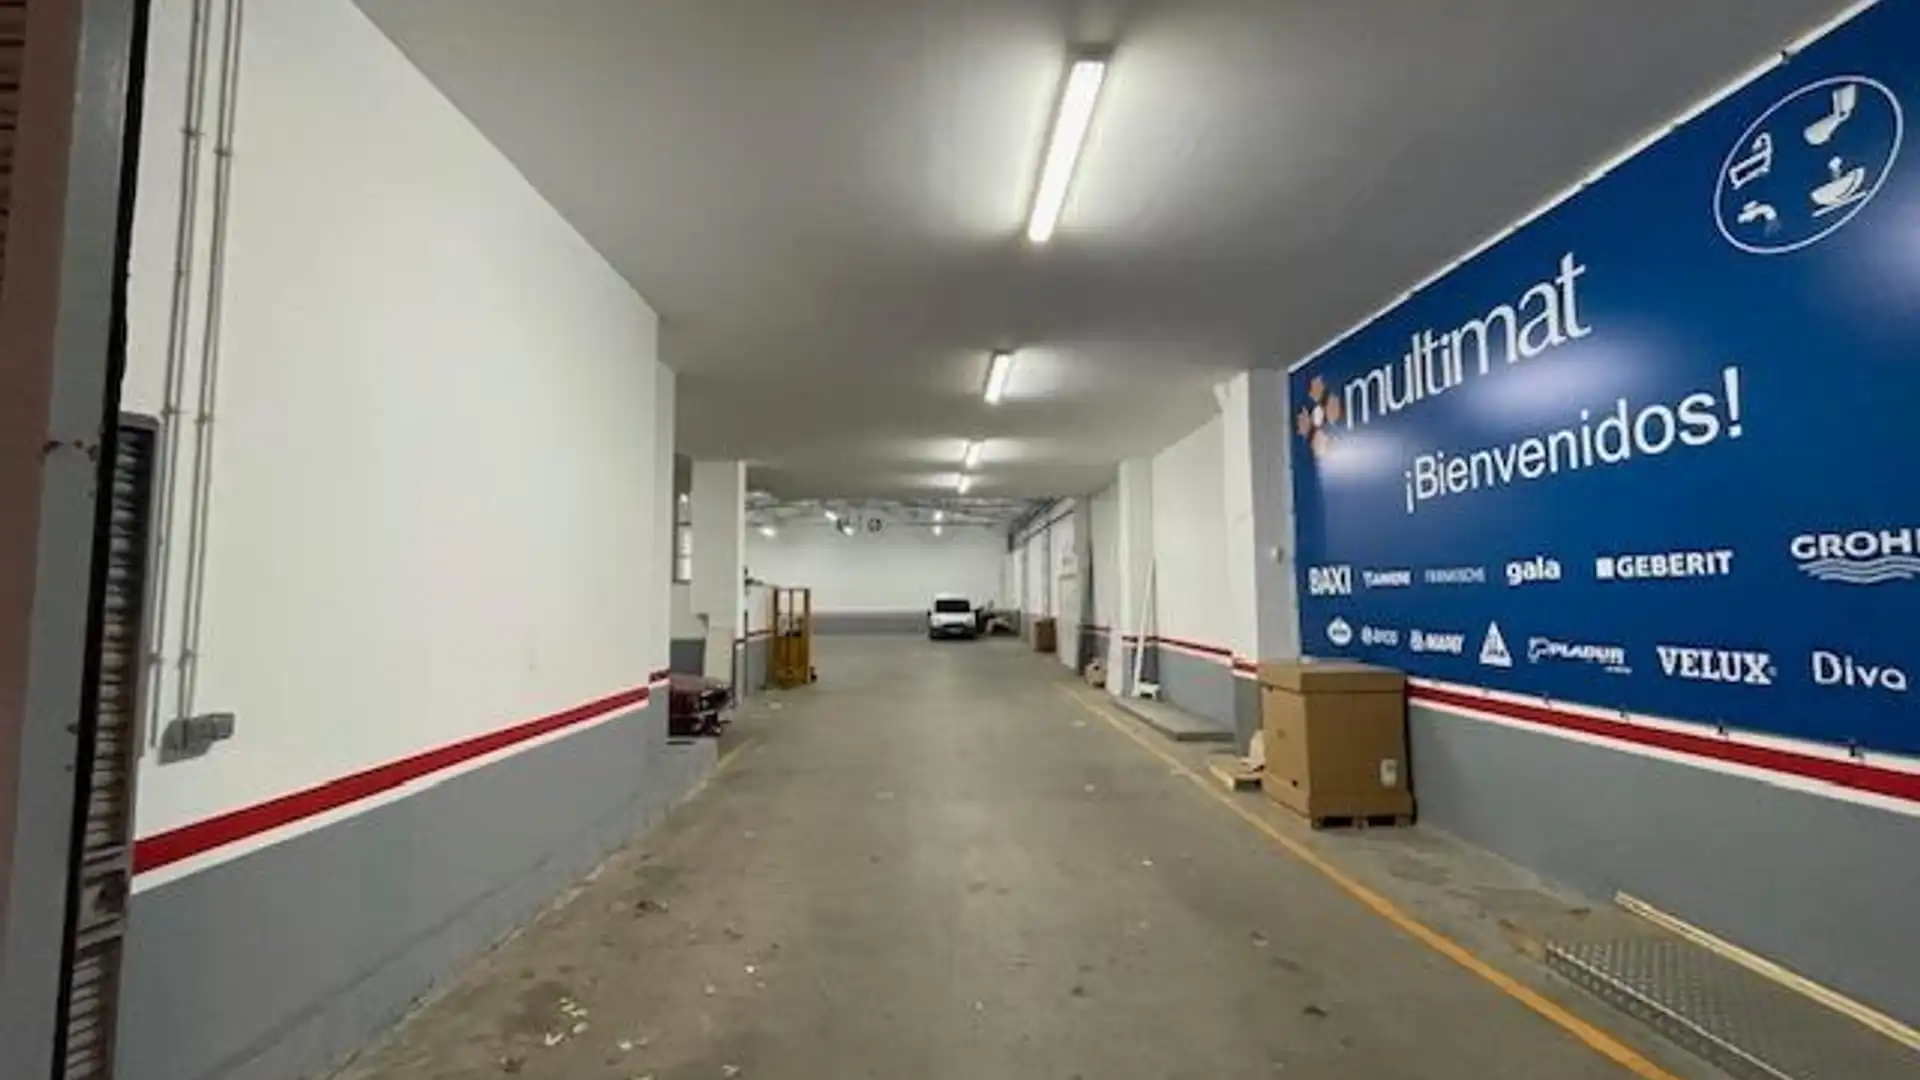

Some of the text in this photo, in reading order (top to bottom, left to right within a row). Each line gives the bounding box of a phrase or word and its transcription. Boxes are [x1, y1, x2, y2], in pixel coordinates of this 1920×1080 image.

[1344, 252, 1593, 430] multimat
[1404, 366, 1743, 513] ¡Bienvenidos!
[1790, 527, 1920, 559] GROH
[1506, 555, 1561, 586] gala
[1616, 550, 1734, 579] GEBERIT
[1656, 646, 1772, 685] VELUX
[1812, 650, 1907, 691] Diva
